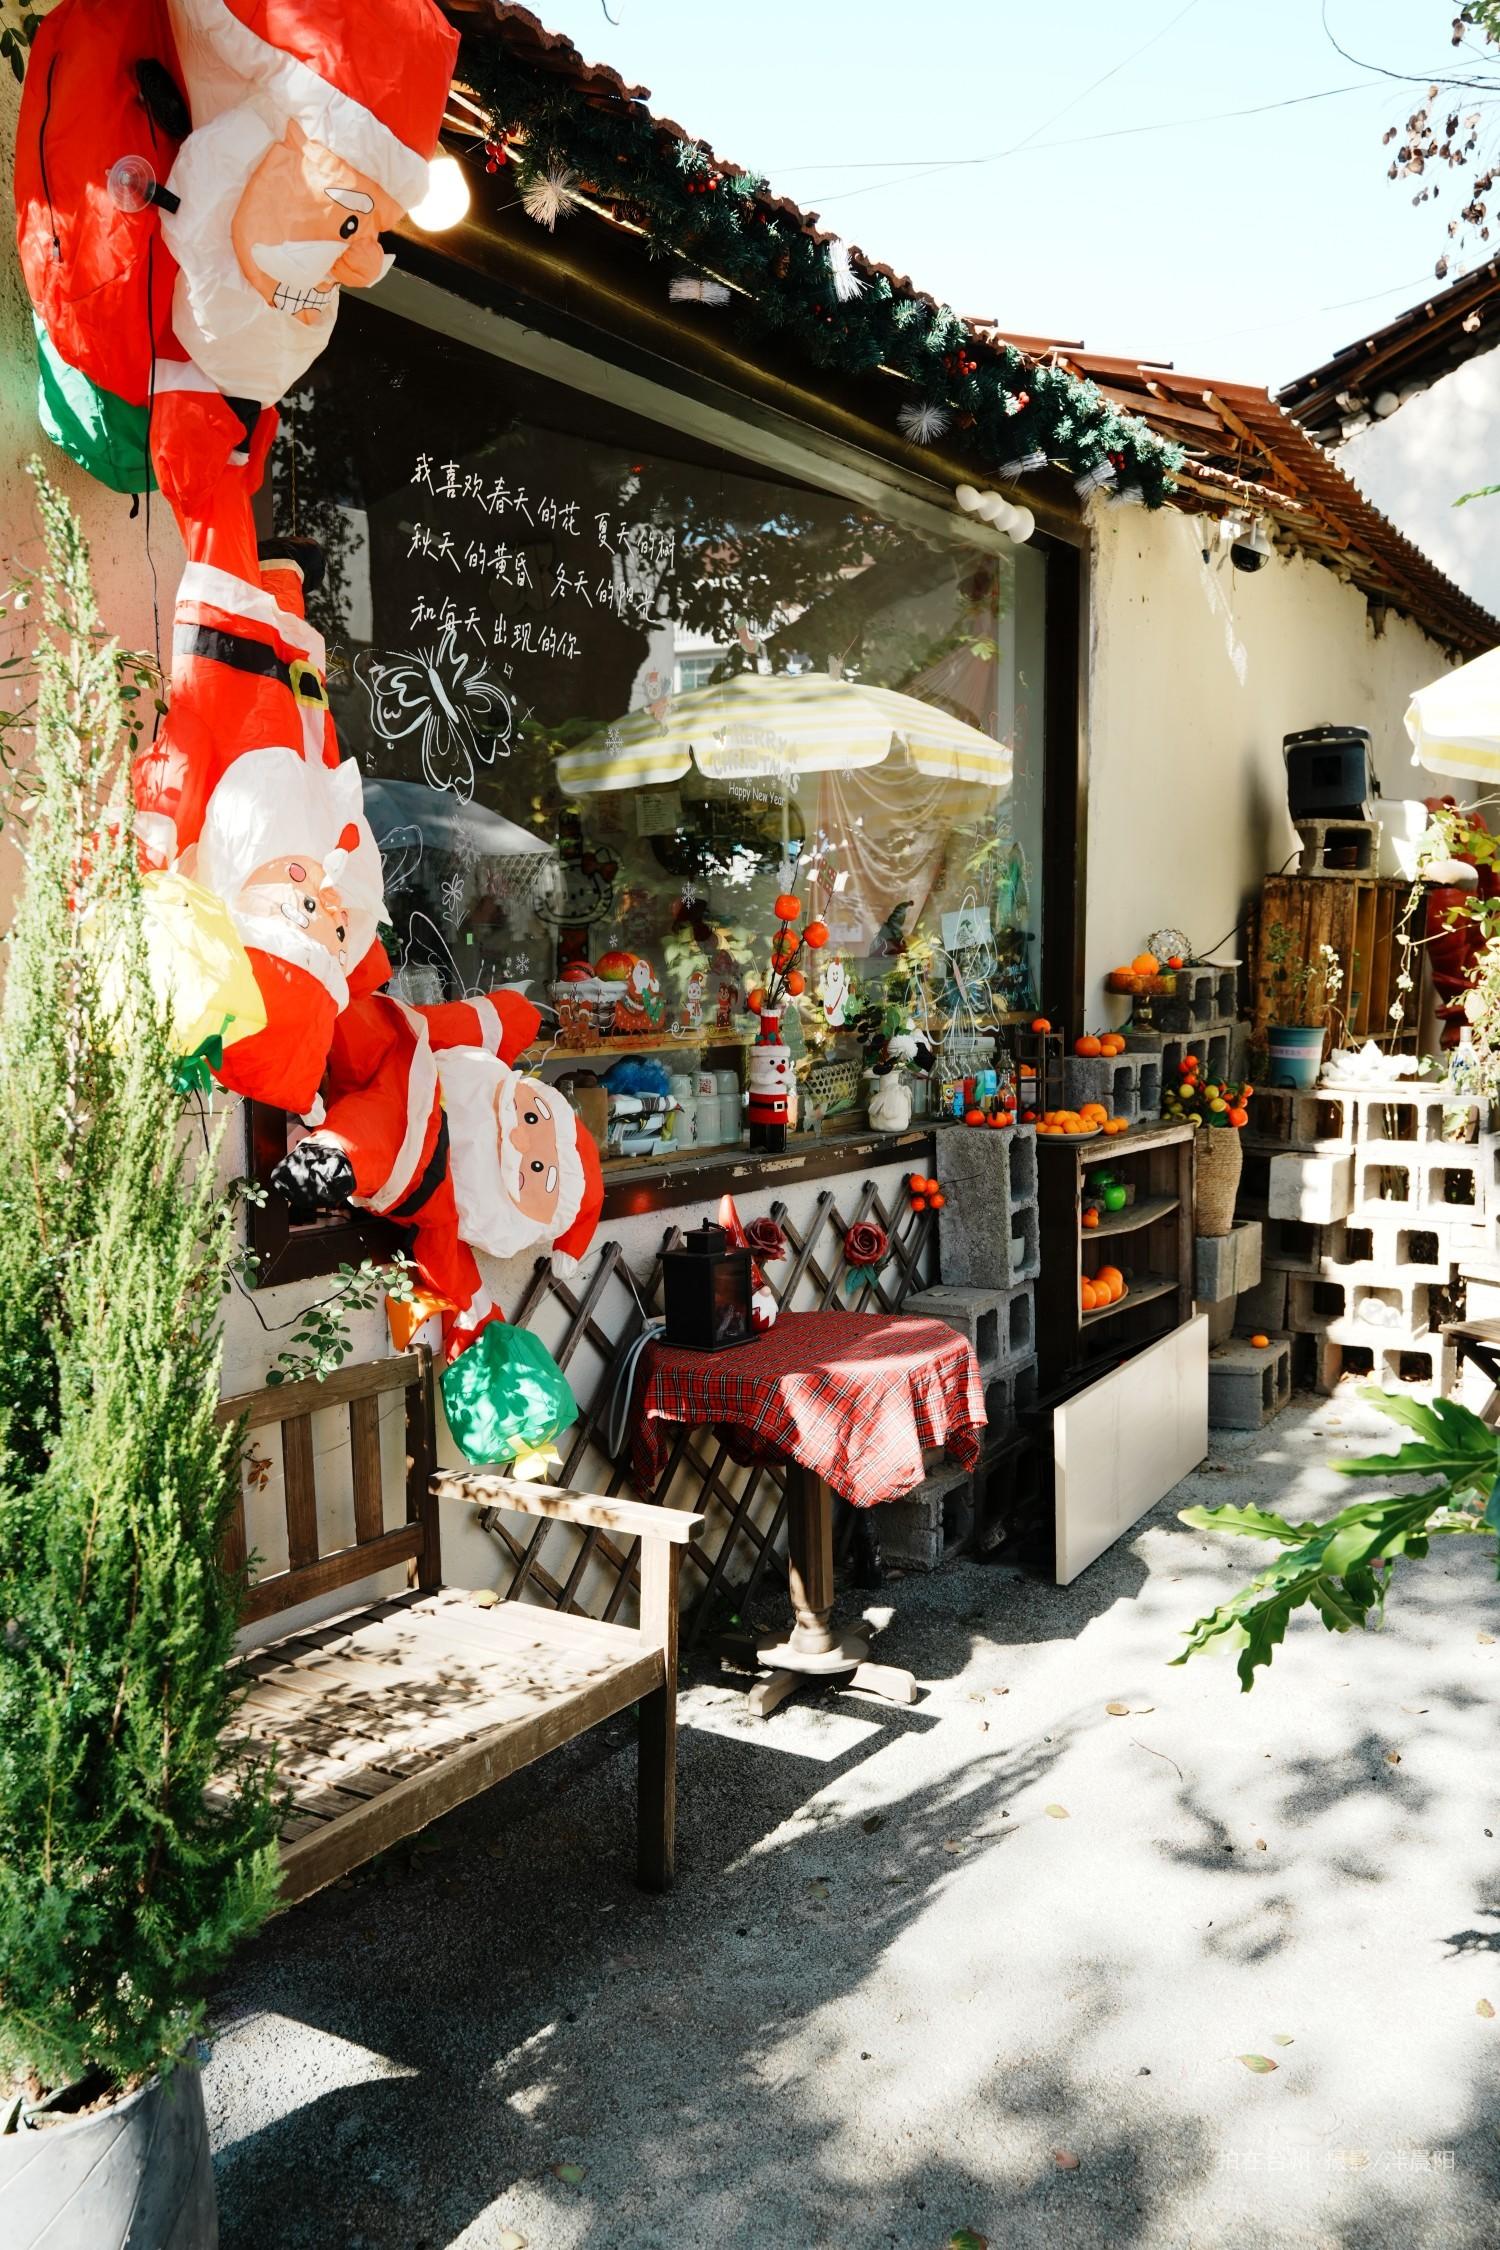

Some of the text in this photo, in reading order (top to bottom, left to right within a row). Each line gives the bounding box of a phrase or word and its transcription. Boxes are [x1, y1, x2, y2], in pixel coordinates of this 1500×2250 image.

[410, 453, 676, 569] 我喜欢春天的花 夏天的树
[407, 523, 656, 623] 秋天的黄昏 冬天的阳光
[410, 596, 581, 660] 和每天出现的你
[729, 782, 785, 806] Happy New Year
